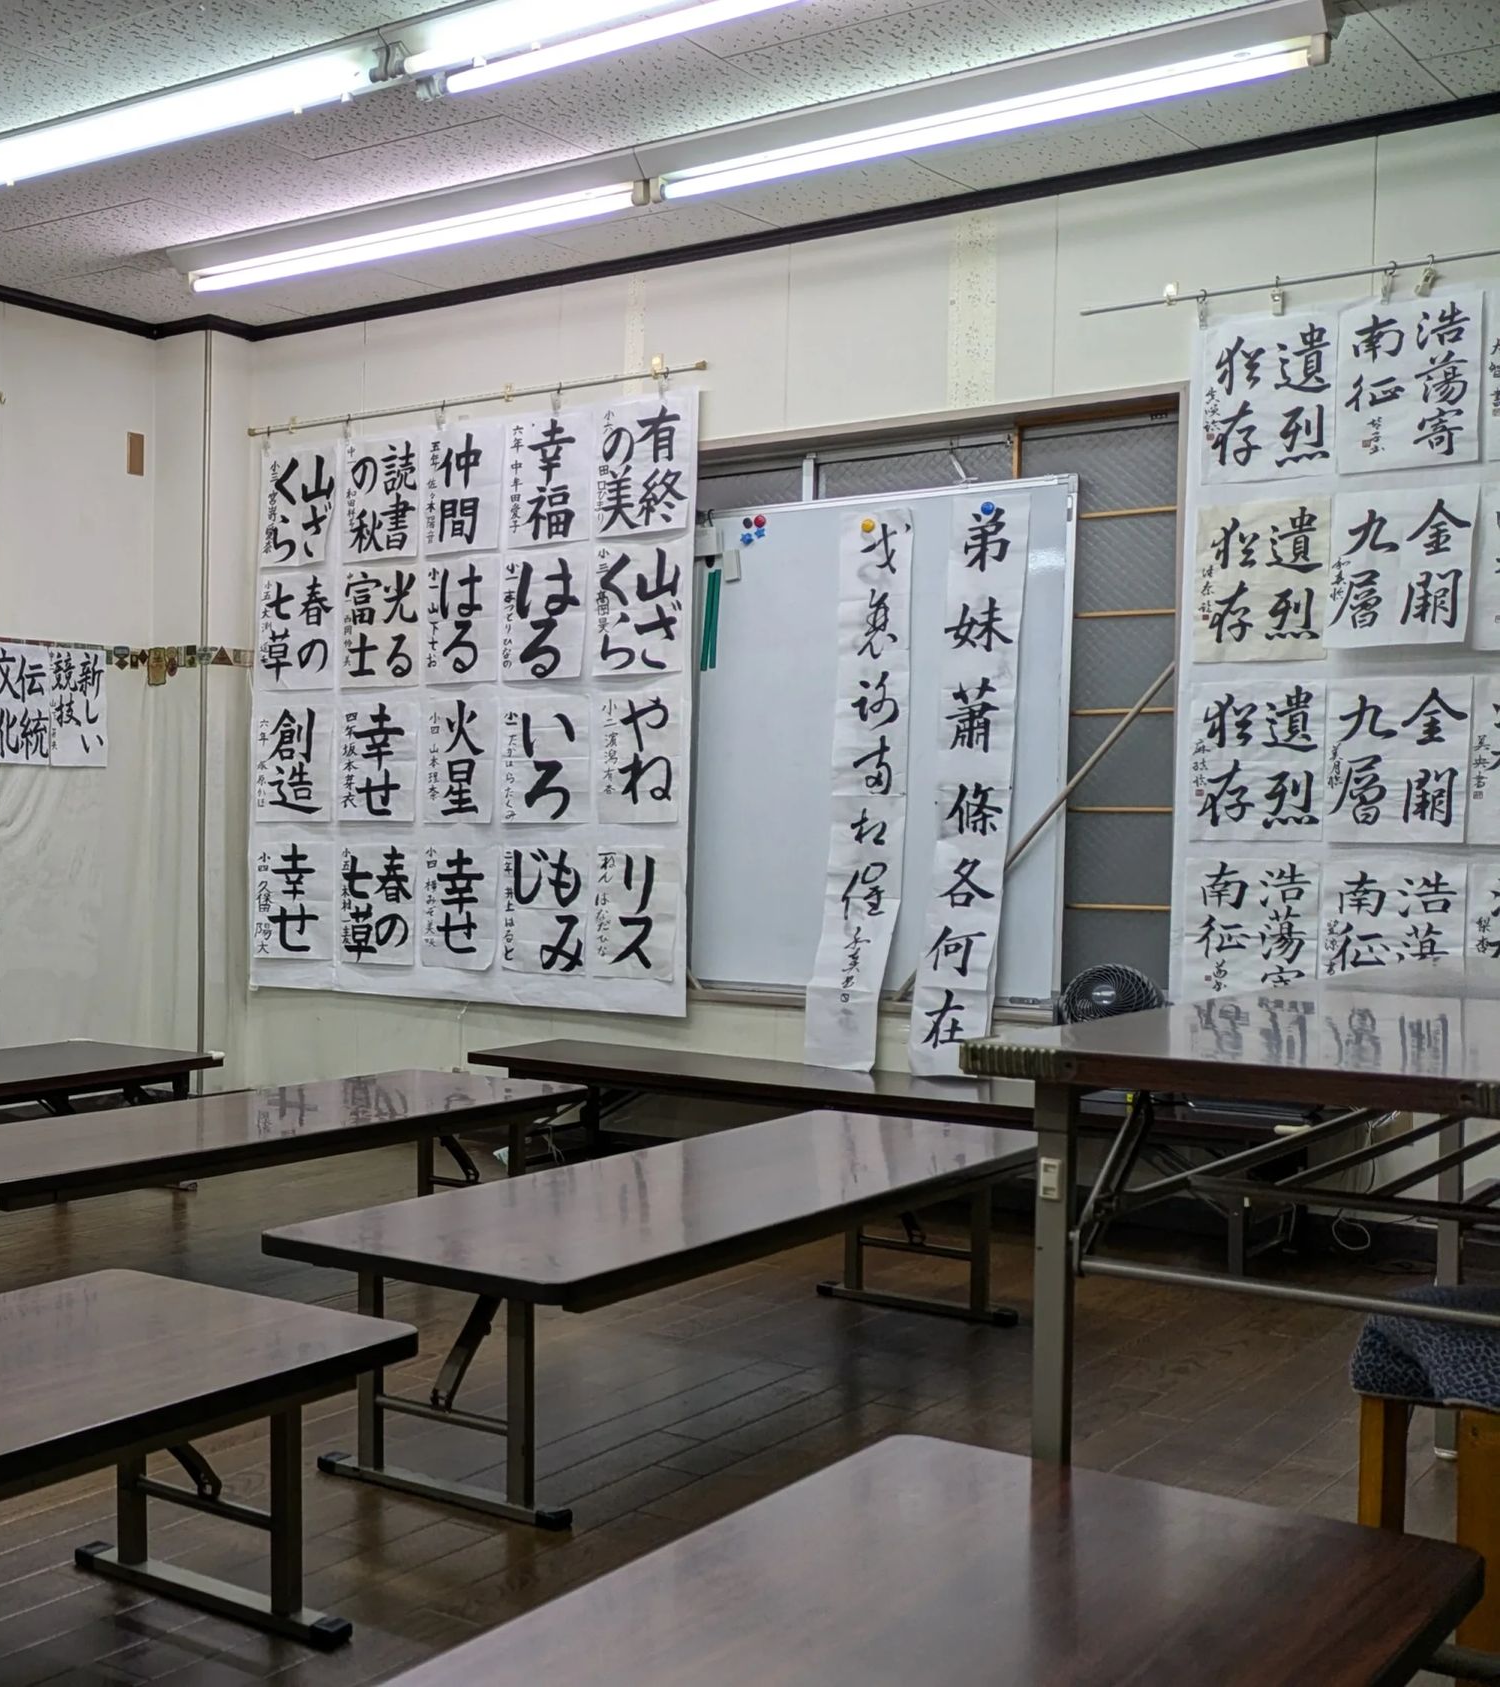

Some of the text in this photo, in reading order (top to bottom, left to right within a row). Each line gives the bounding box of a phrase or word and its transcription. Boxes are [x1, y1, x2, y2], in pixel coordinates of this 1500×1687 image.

[1273, 322, 1332, 469] 遺烈
[1345, 314, 1405, 413] 南征
[437, 432, 484, 546] 仲間
[510, 424, 525, 454] 六年
[524, 418, 577, 541] 幸福
[600, 427, 642, 533] の美
[635, 405, 689, 526] 有終
[274, 456, 300, 563] くら
[301, 455, 335, 558] 山ざ
[350, 456, 385, 554] の秋
[380, 439, 418, 551] 読書
[297, 574, 335, 674] 春の
[345, 571, 383, 678] 富士
[383, 570, 419, 679] 光る
[440, 563, 484, 675] はる
[516, 557, 581, 679] はる
[600, 553, 636, 671] くら
[634, 547, 683, 670] 山ざ
[1264, 506, 1324, 642] 遺烈
[265, 581, 296, 683] 七草
[15, 654, 50, 761] 伝統
[52, 651, 82, 728] 競技
[77, 652, 105, 754] 新しい
[268, 707, 324, 815] 創造
[353, 703, 405, 816] 幸せ
[441, 699, 486, 816] 火星
[522, 712, 576, 820] いろ
[618, 696, 672, 805] やね
[1262, 685, 1320, 830] 遺烈
[267, 842, 320, 952] 幸せ
[342, 855, 378, 963] 七草
[375, 845, 413, 948] 春の
[437, 848, 485, 954] 幸せ
[513, 848, 549, 905] じ
[540, 848, 584, 972] もみ
[1194, 862, 1252, 958] 南征
[1332, 871, 1391, 972] 南征
